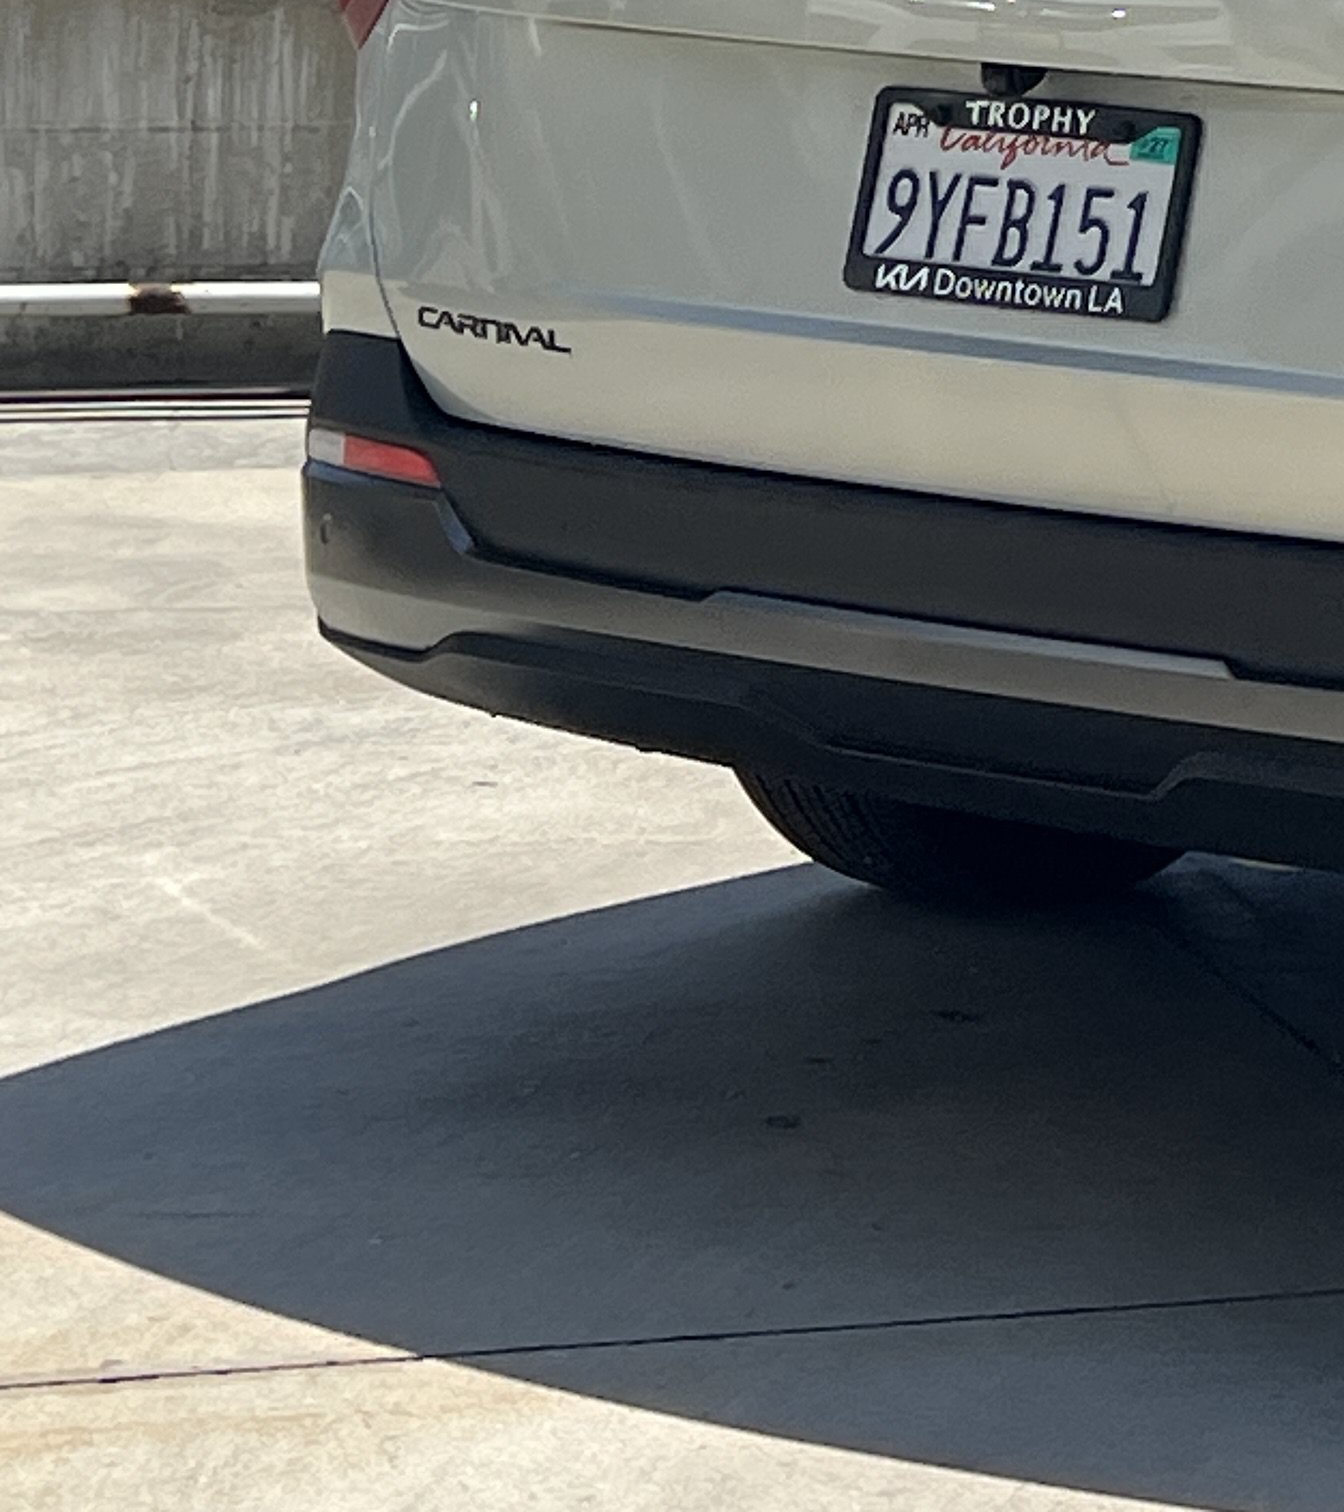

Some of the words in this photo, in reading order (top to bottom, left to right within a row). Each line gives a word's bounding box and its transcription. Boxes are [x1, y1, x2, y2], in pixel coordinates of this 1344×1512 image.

[893, 111, 931, 138] APR
[966, 99, 1096, 136] TROPHY
[876, 168, 1150, 282] 9YFB151
[875, 263, 931, 291] KIA
[932, 267, 1081, 310] Downtown
[1087, 285, 1124, 315] LA
